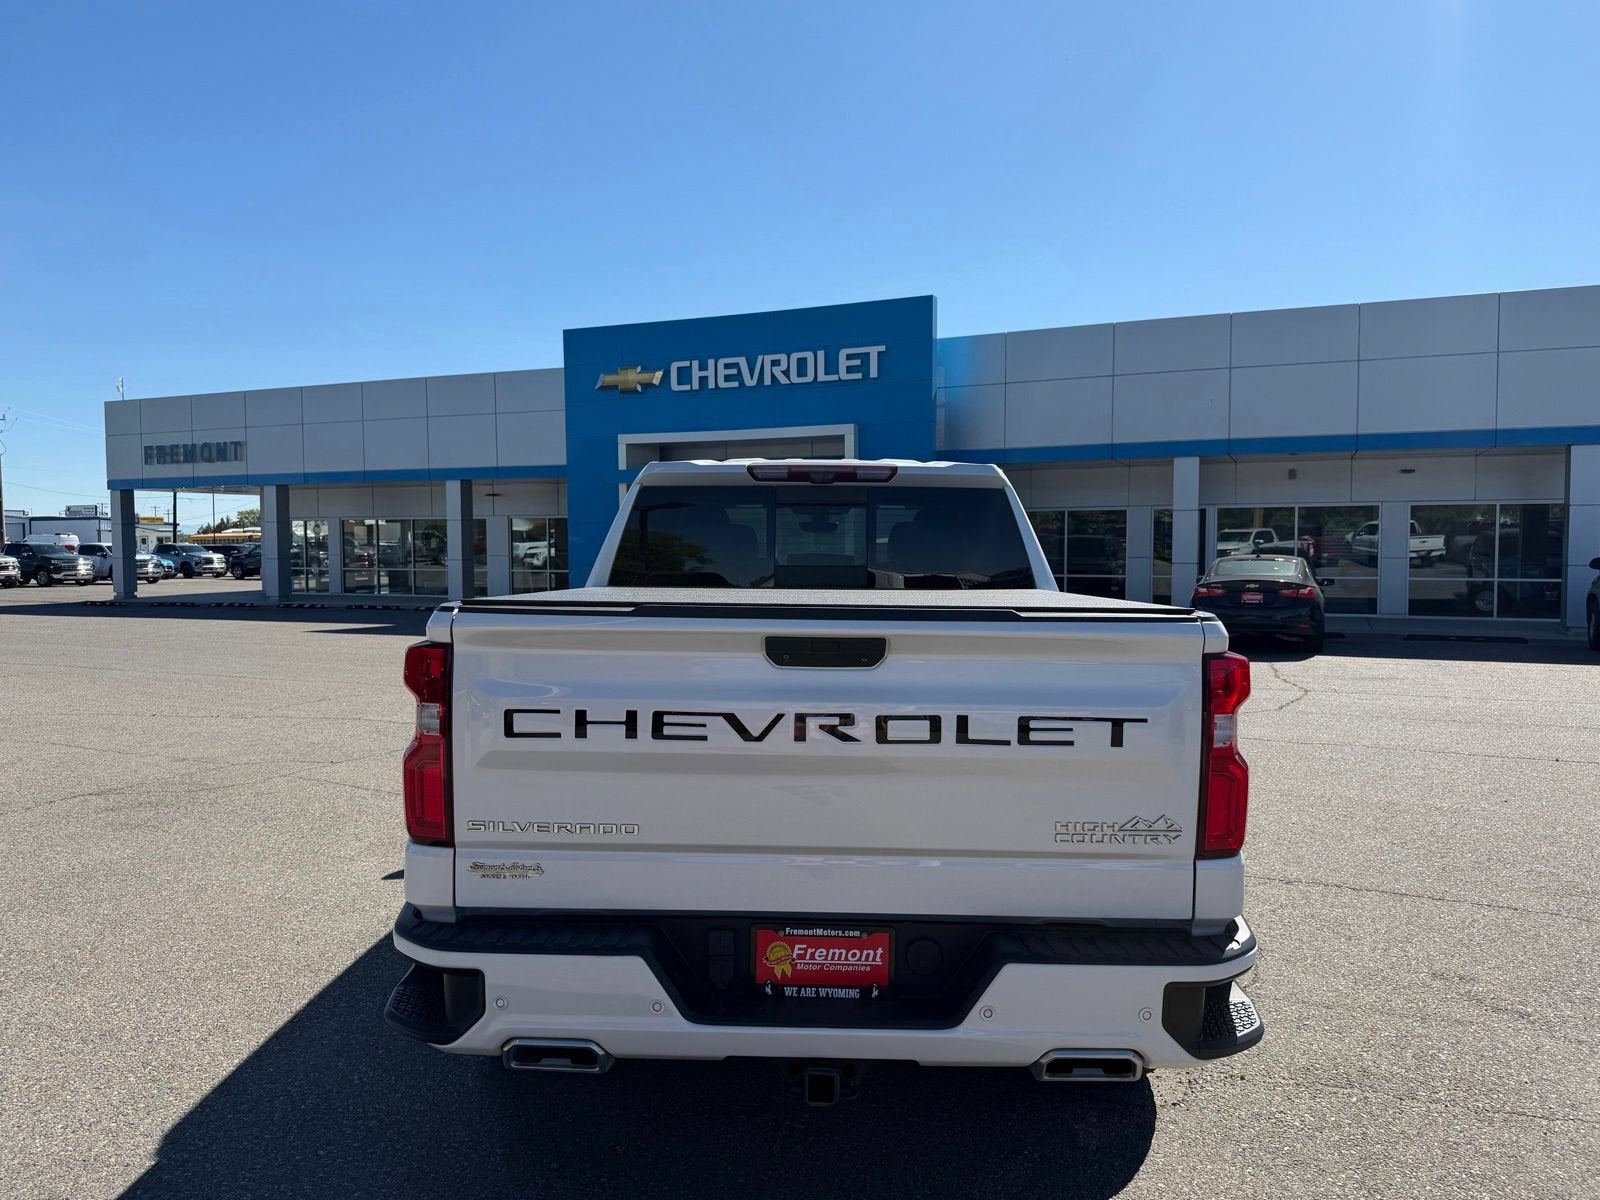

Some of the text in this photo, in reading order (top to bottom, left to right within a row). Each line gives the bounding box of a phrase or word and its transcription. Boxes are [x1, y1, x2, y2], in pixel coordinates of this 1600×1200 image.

[670, 345, 886, 391] CHEVROLET
[143, 441, 246, 465] FREMONT
[503, 708, 1148, 748] CHEVROLET
[467, 820, 640, 835] SILVERADO
[1054, 821, 1119, 833] HIGH
[1054, 833, 1182, 845] COUNTRY
[785, 927, 861, 937] FremontMotors.com
[792, 944, 883, 962] Fremont
[823, 964, 871, 972] Companies
[784, 987, 860, 998] WE ARE WYOMING
